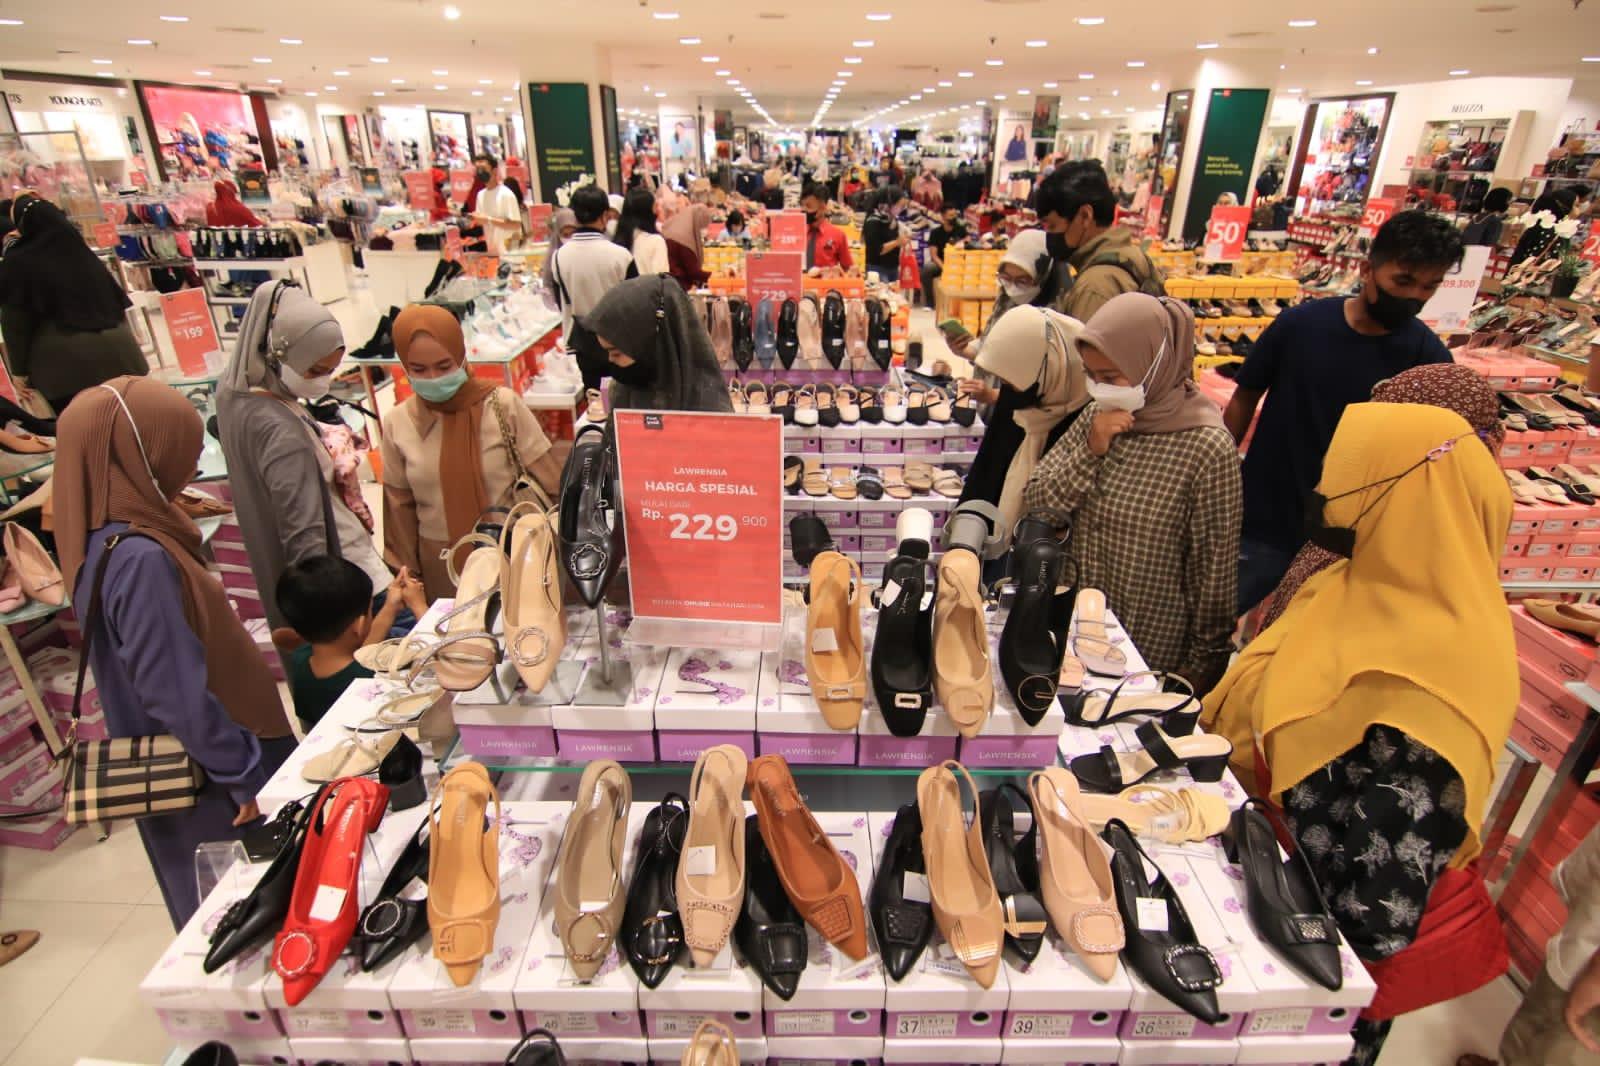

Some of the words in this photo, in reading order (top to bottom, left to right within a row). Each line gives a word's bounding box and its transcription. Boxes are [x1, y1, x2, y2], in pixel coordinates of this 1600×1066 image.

[1363, 208, 1385, 226] 50
[1210, 221, 1241, 245] 50
[673, 467, 727, 476] LAWRENSIA
[644, 481, 695, 493] HARGA
[699, 483, 758, 496] SPESIAL
[642, 508, 664, 521] Rp.
[668, 512, 738, 542] 229
[741, 515, 768, 527] 900
[575, 744, 633, 753] LAWRENSIA
[779, 747, 837, 756] LAWRENSIA
[875, 752, 935, 761] LAWRENSIA
[979, 752, 1037, 760] LAWRENSIA
[900, 1020, 919, 1034] 37
[1014, 1020, 1033, 1034] 39
[1135, 1020, 1155, 1035] 36
[1251, 1017, 1273, 1032] 37
